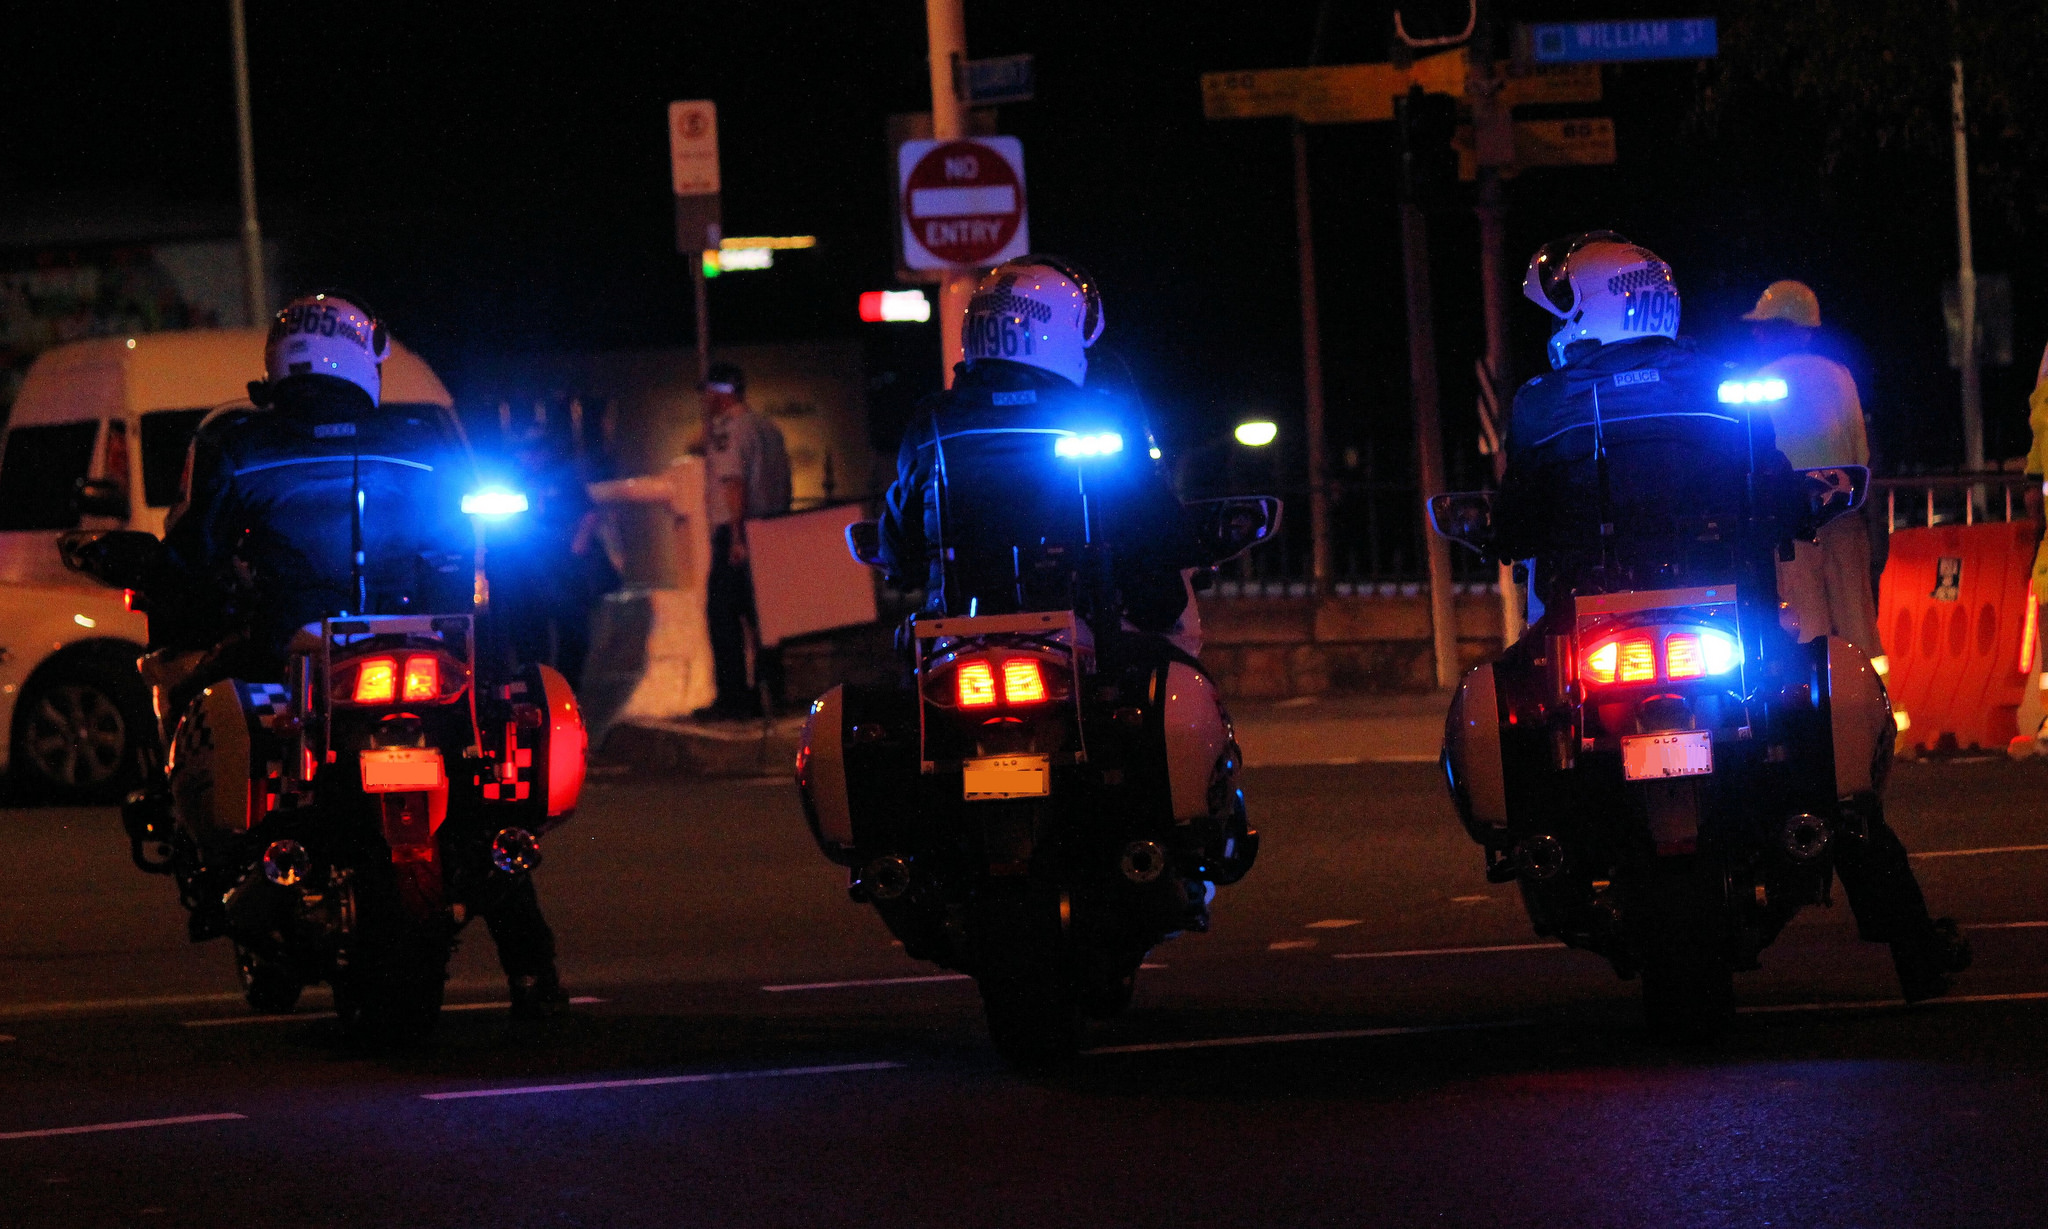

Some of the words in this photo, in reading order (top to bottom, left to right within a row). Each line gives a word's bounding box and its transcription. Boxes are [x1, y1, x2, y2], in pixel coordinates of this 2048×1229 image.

[1576, 21, 1669, 49] WILLIAM
[944, 155, 980, 180] NO
[926, 218, 1004, 247] ENTRY
[968, 314, 1031, 357] M961
[1615, 369, 1659, 385] POLICE
